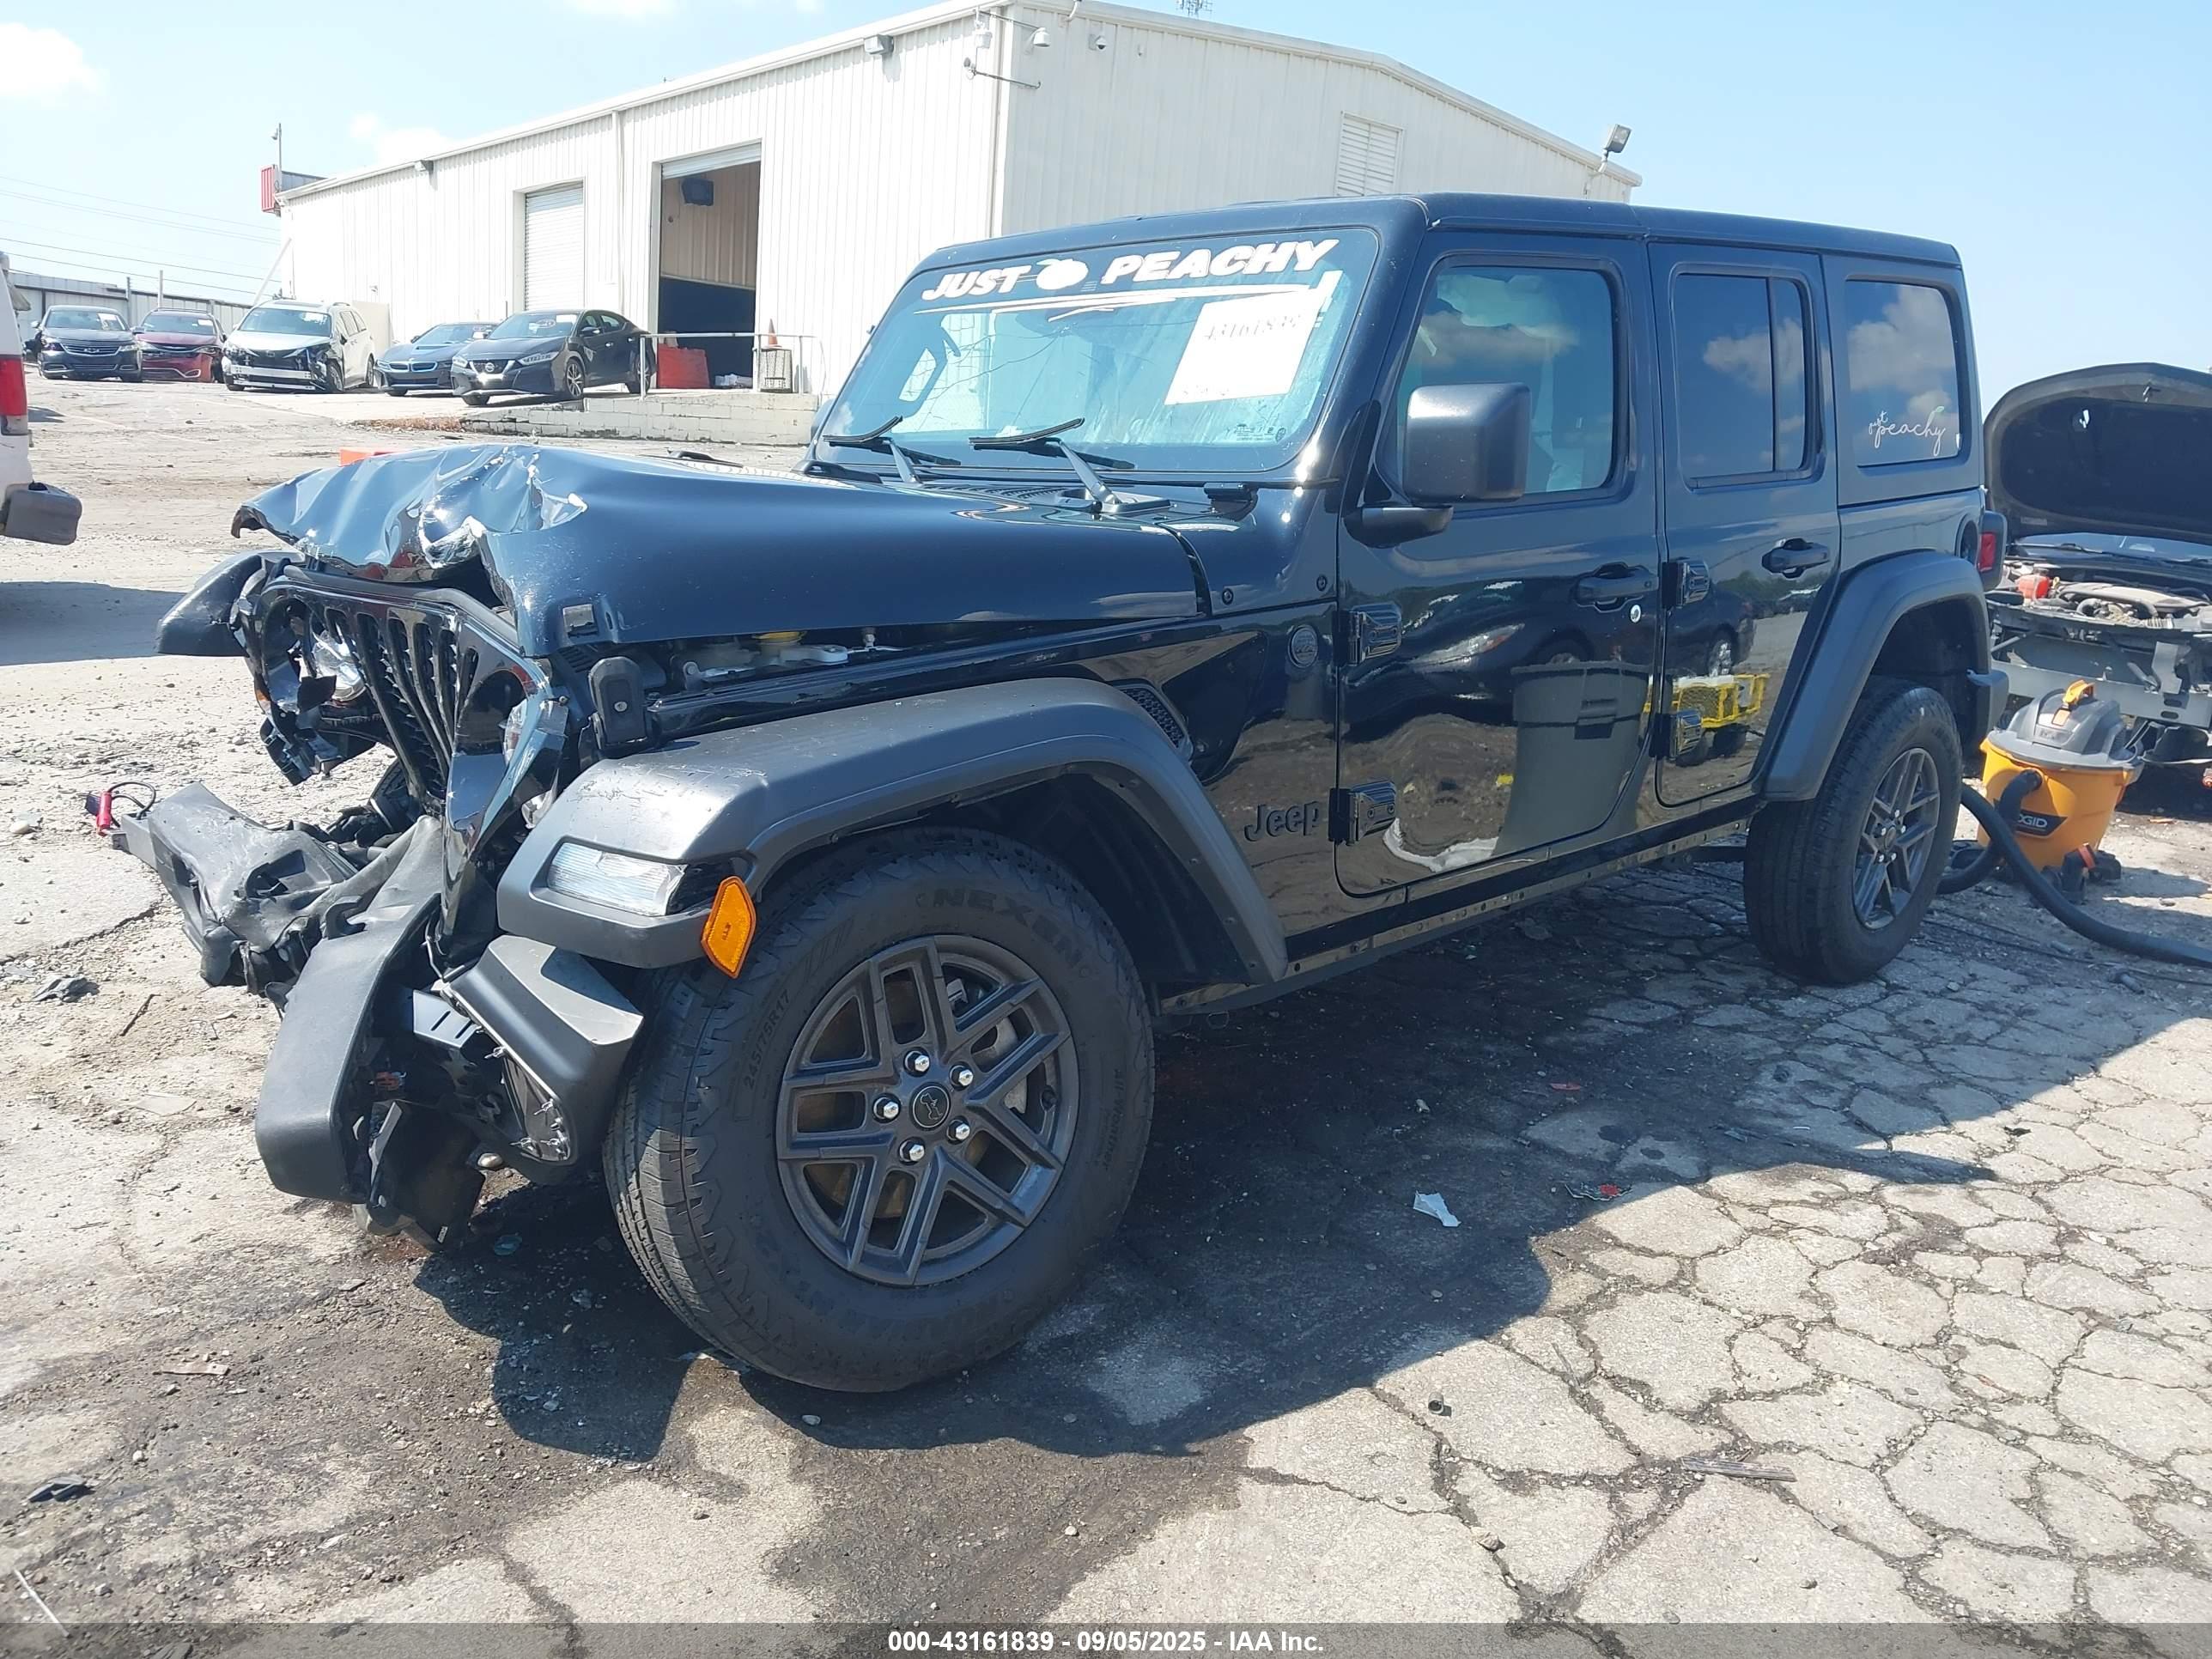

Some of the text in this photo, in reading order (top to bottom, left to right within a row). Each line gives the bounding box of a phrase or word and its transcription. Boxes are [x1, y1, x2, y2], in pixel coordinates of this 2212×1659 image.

[921, 239, 1340, 301] JUST PEACHY
[1868, 410, 1889, 435] just
[1874, 407, 1946, 457] peachy
[1243, 801, 1321, 842] Jeep
[743, 988, 791, 1091] 245/75R17
